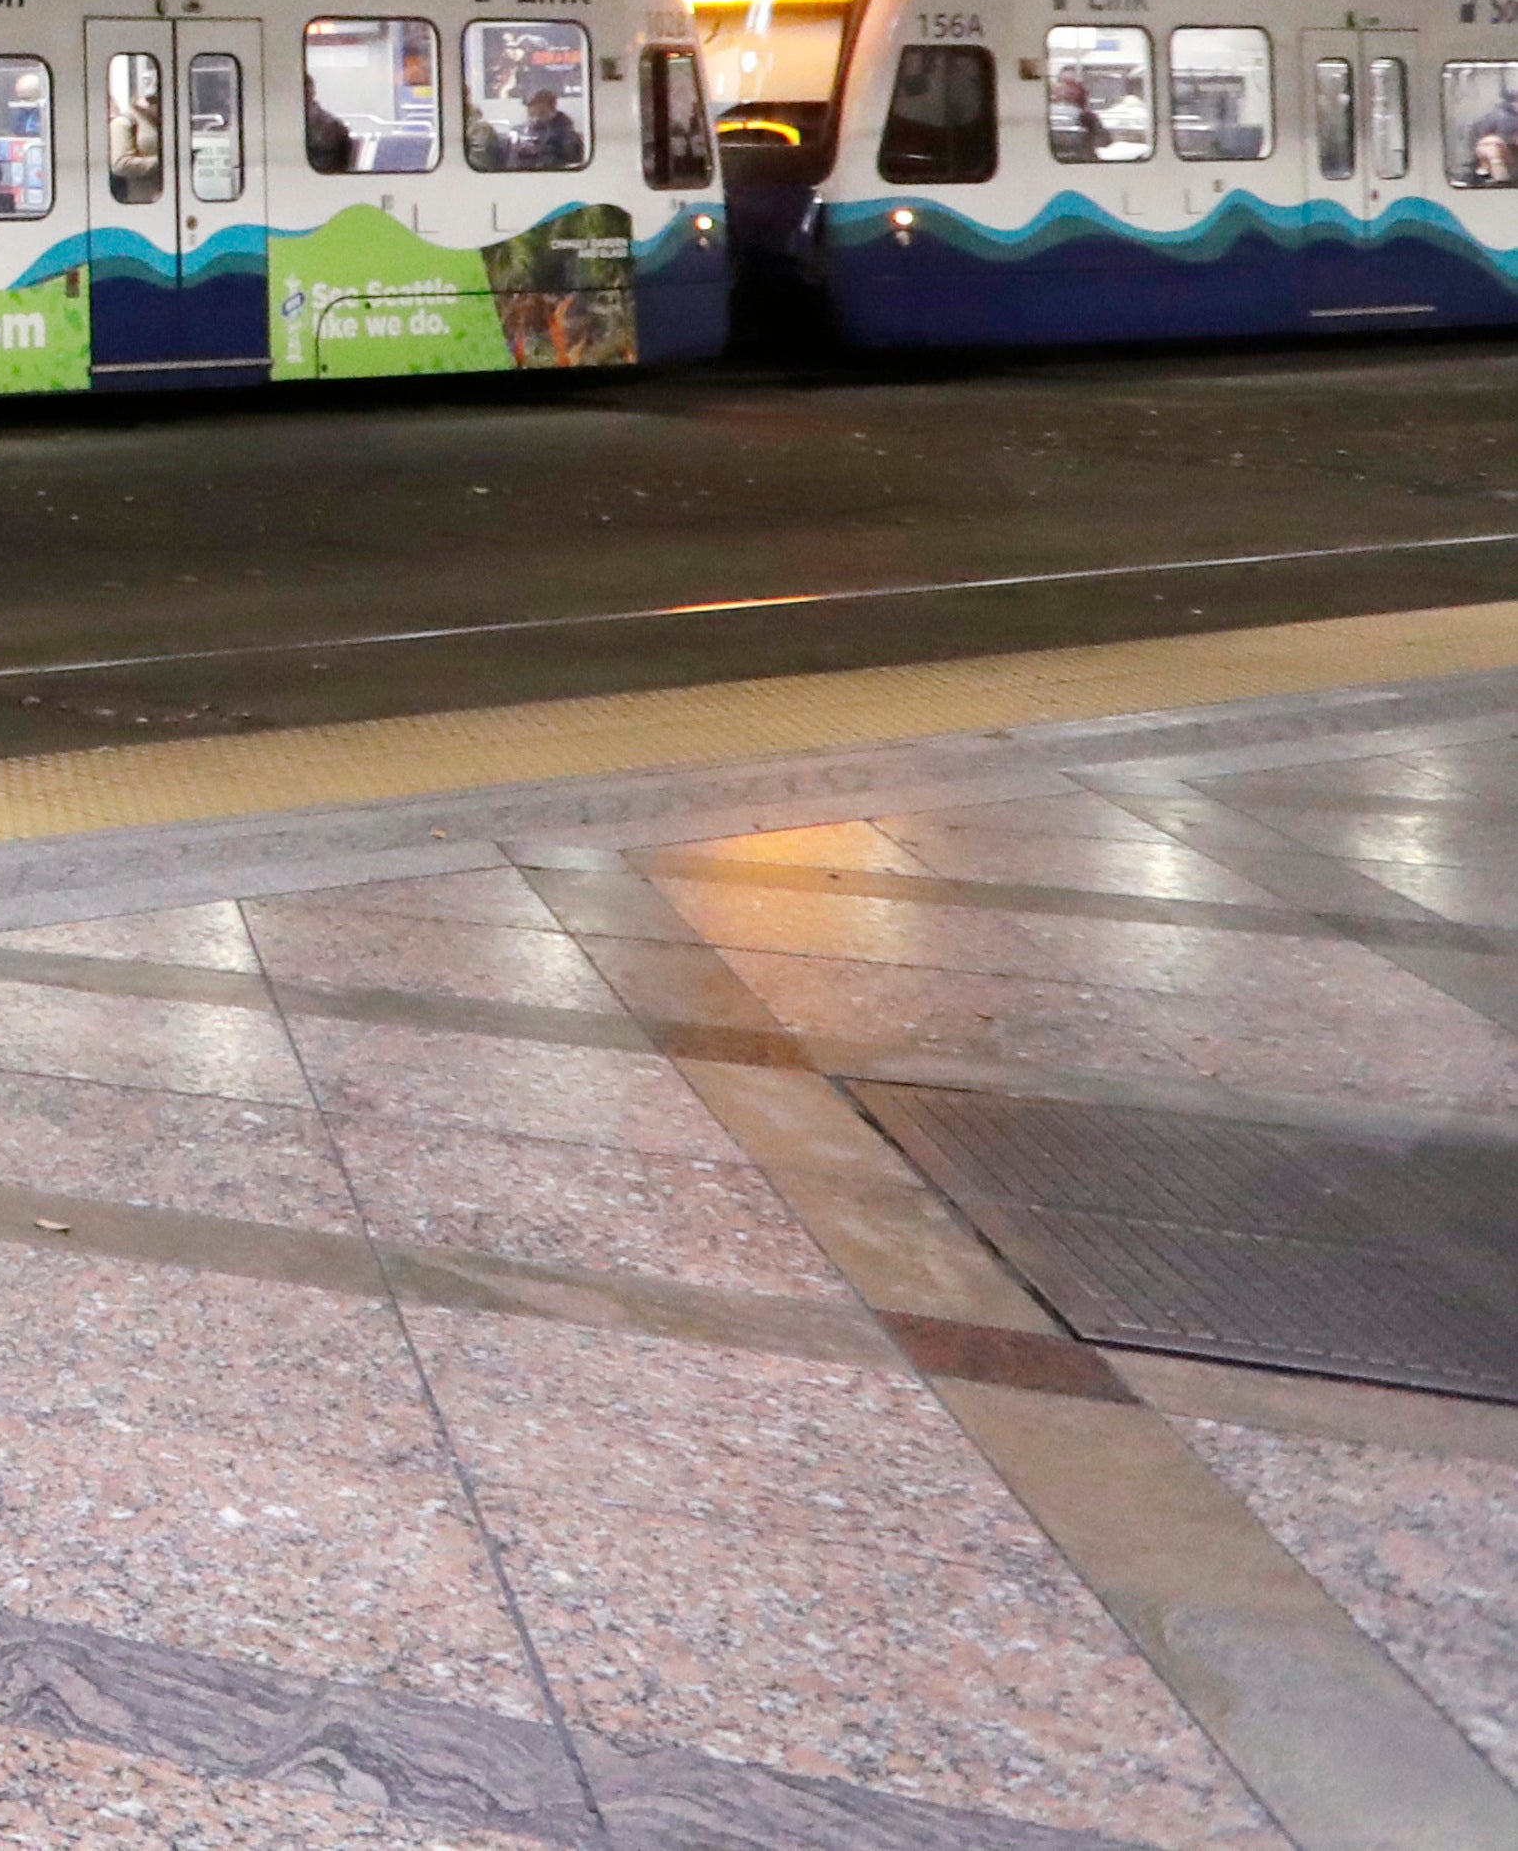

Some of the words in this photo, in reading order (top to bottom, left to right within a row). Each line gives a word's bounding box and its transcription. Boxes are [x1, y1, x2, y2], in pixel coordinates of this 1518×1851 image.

[918, 13, 986, 39] 156A
[311, 282, 360, 309] See
[366, 277, 458, 307] Seattle
[313, 309, 360, 340] like
[365, 315, 403, 338] we
[409, 307, 452, 336] do.
